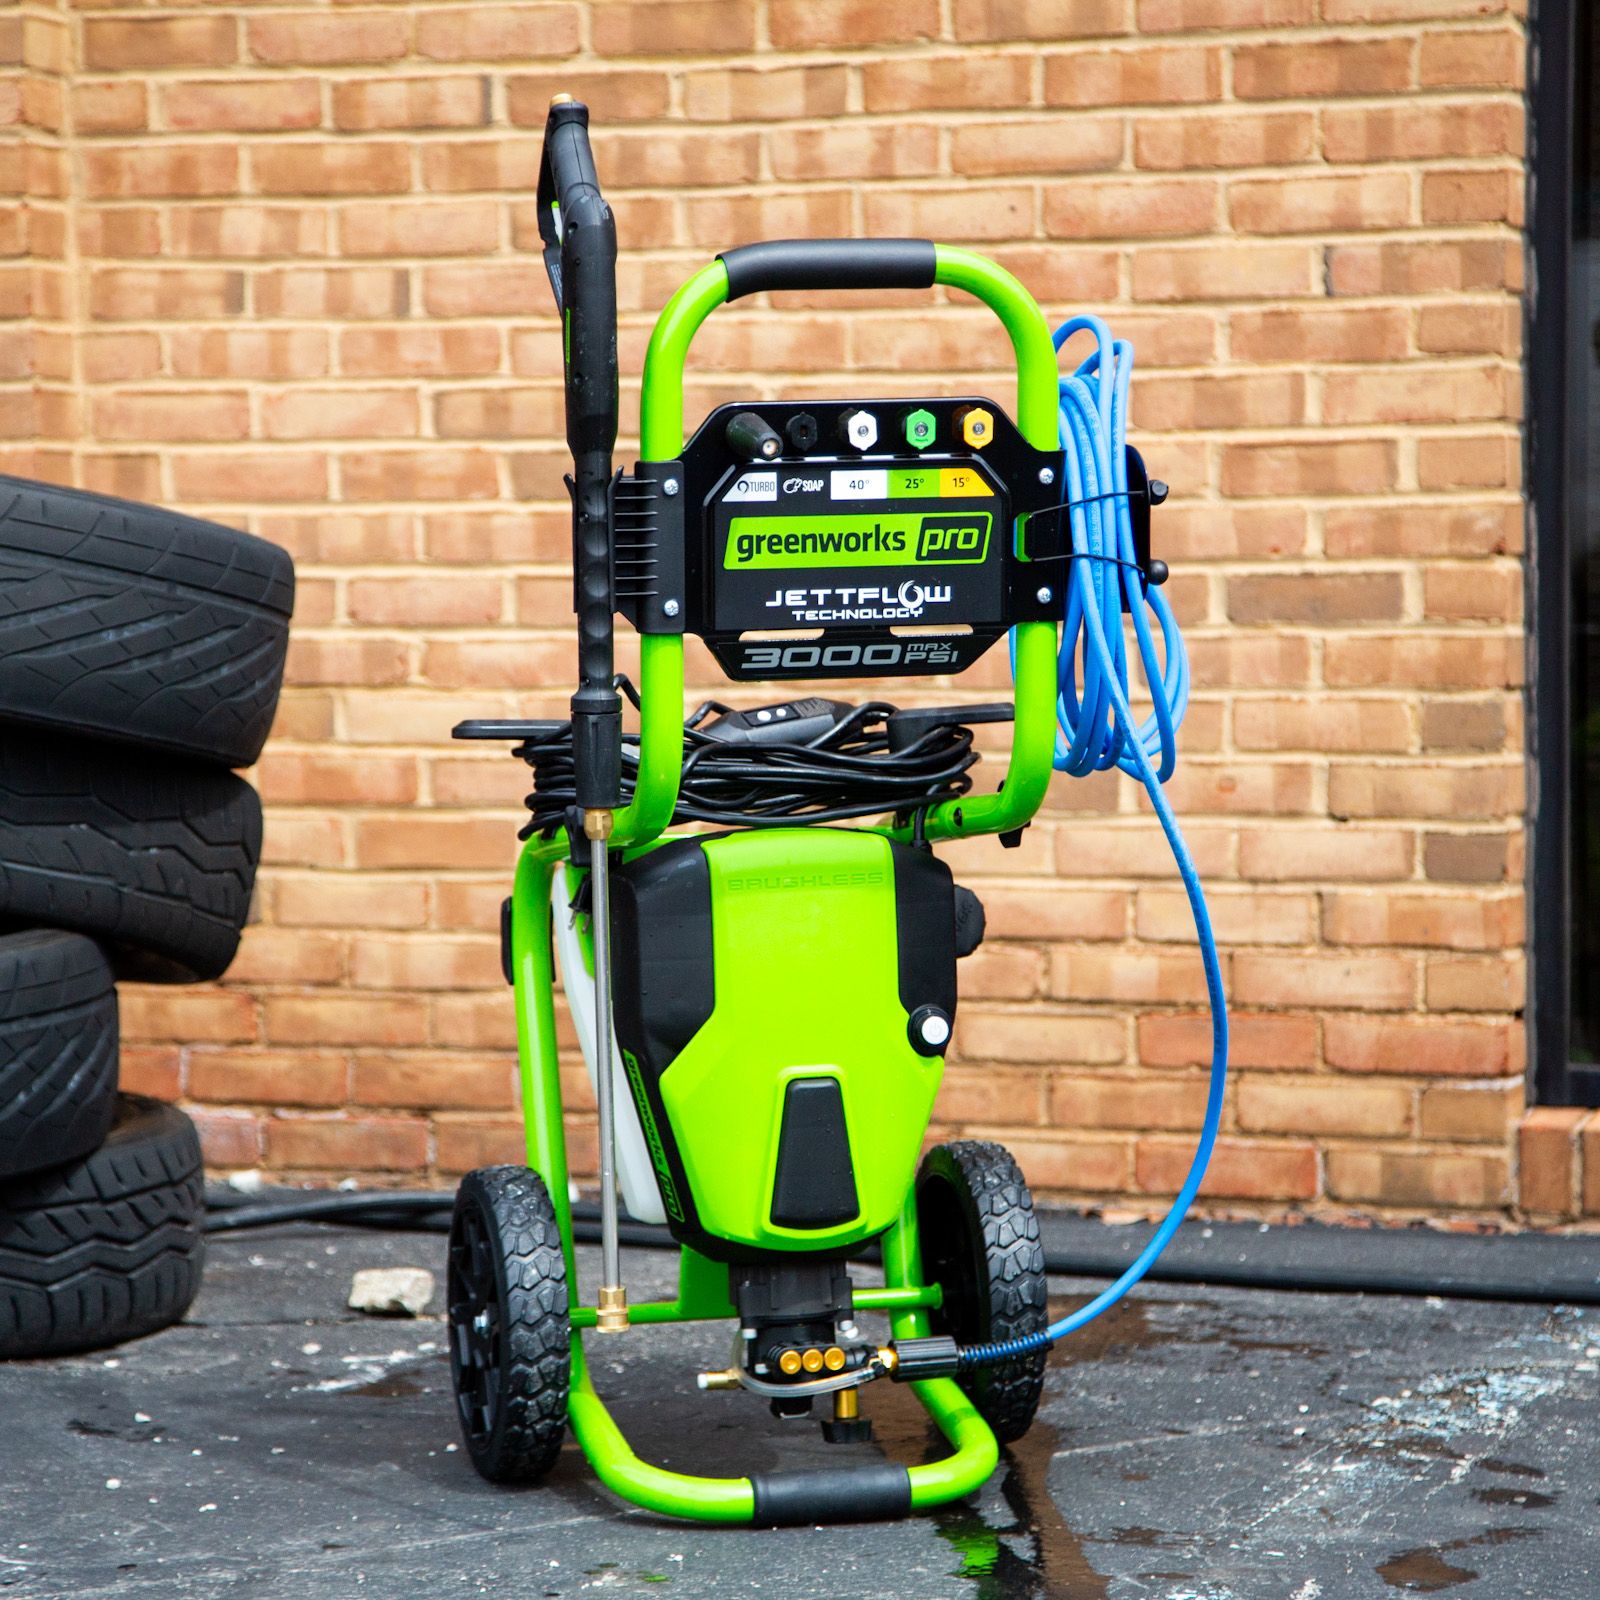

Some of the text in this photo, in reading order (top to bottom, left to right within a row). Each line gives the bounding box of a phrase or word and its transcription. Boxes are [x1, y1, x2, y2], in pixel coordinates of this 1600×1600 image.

[750, 481, 775, 492] TURBO
[802, 479, 824, 492] SOAP
[849, 479, 870, 490] 40°
[905, 478, 925, 489] 25°
[953, 477, 970, 488] 15°
[737, 524, 980, 563] greenworks pro
[765, 580, 951, 609] JETTFLOW
[792, 608, 923, 621] TECHNOLOGY
[907, 642, 952, 651] MAX
[741, 644, 903, 669] 3000
[904, 650, 959, 664] PSI
[728, 872, 883, 891] BRUSHLESS
